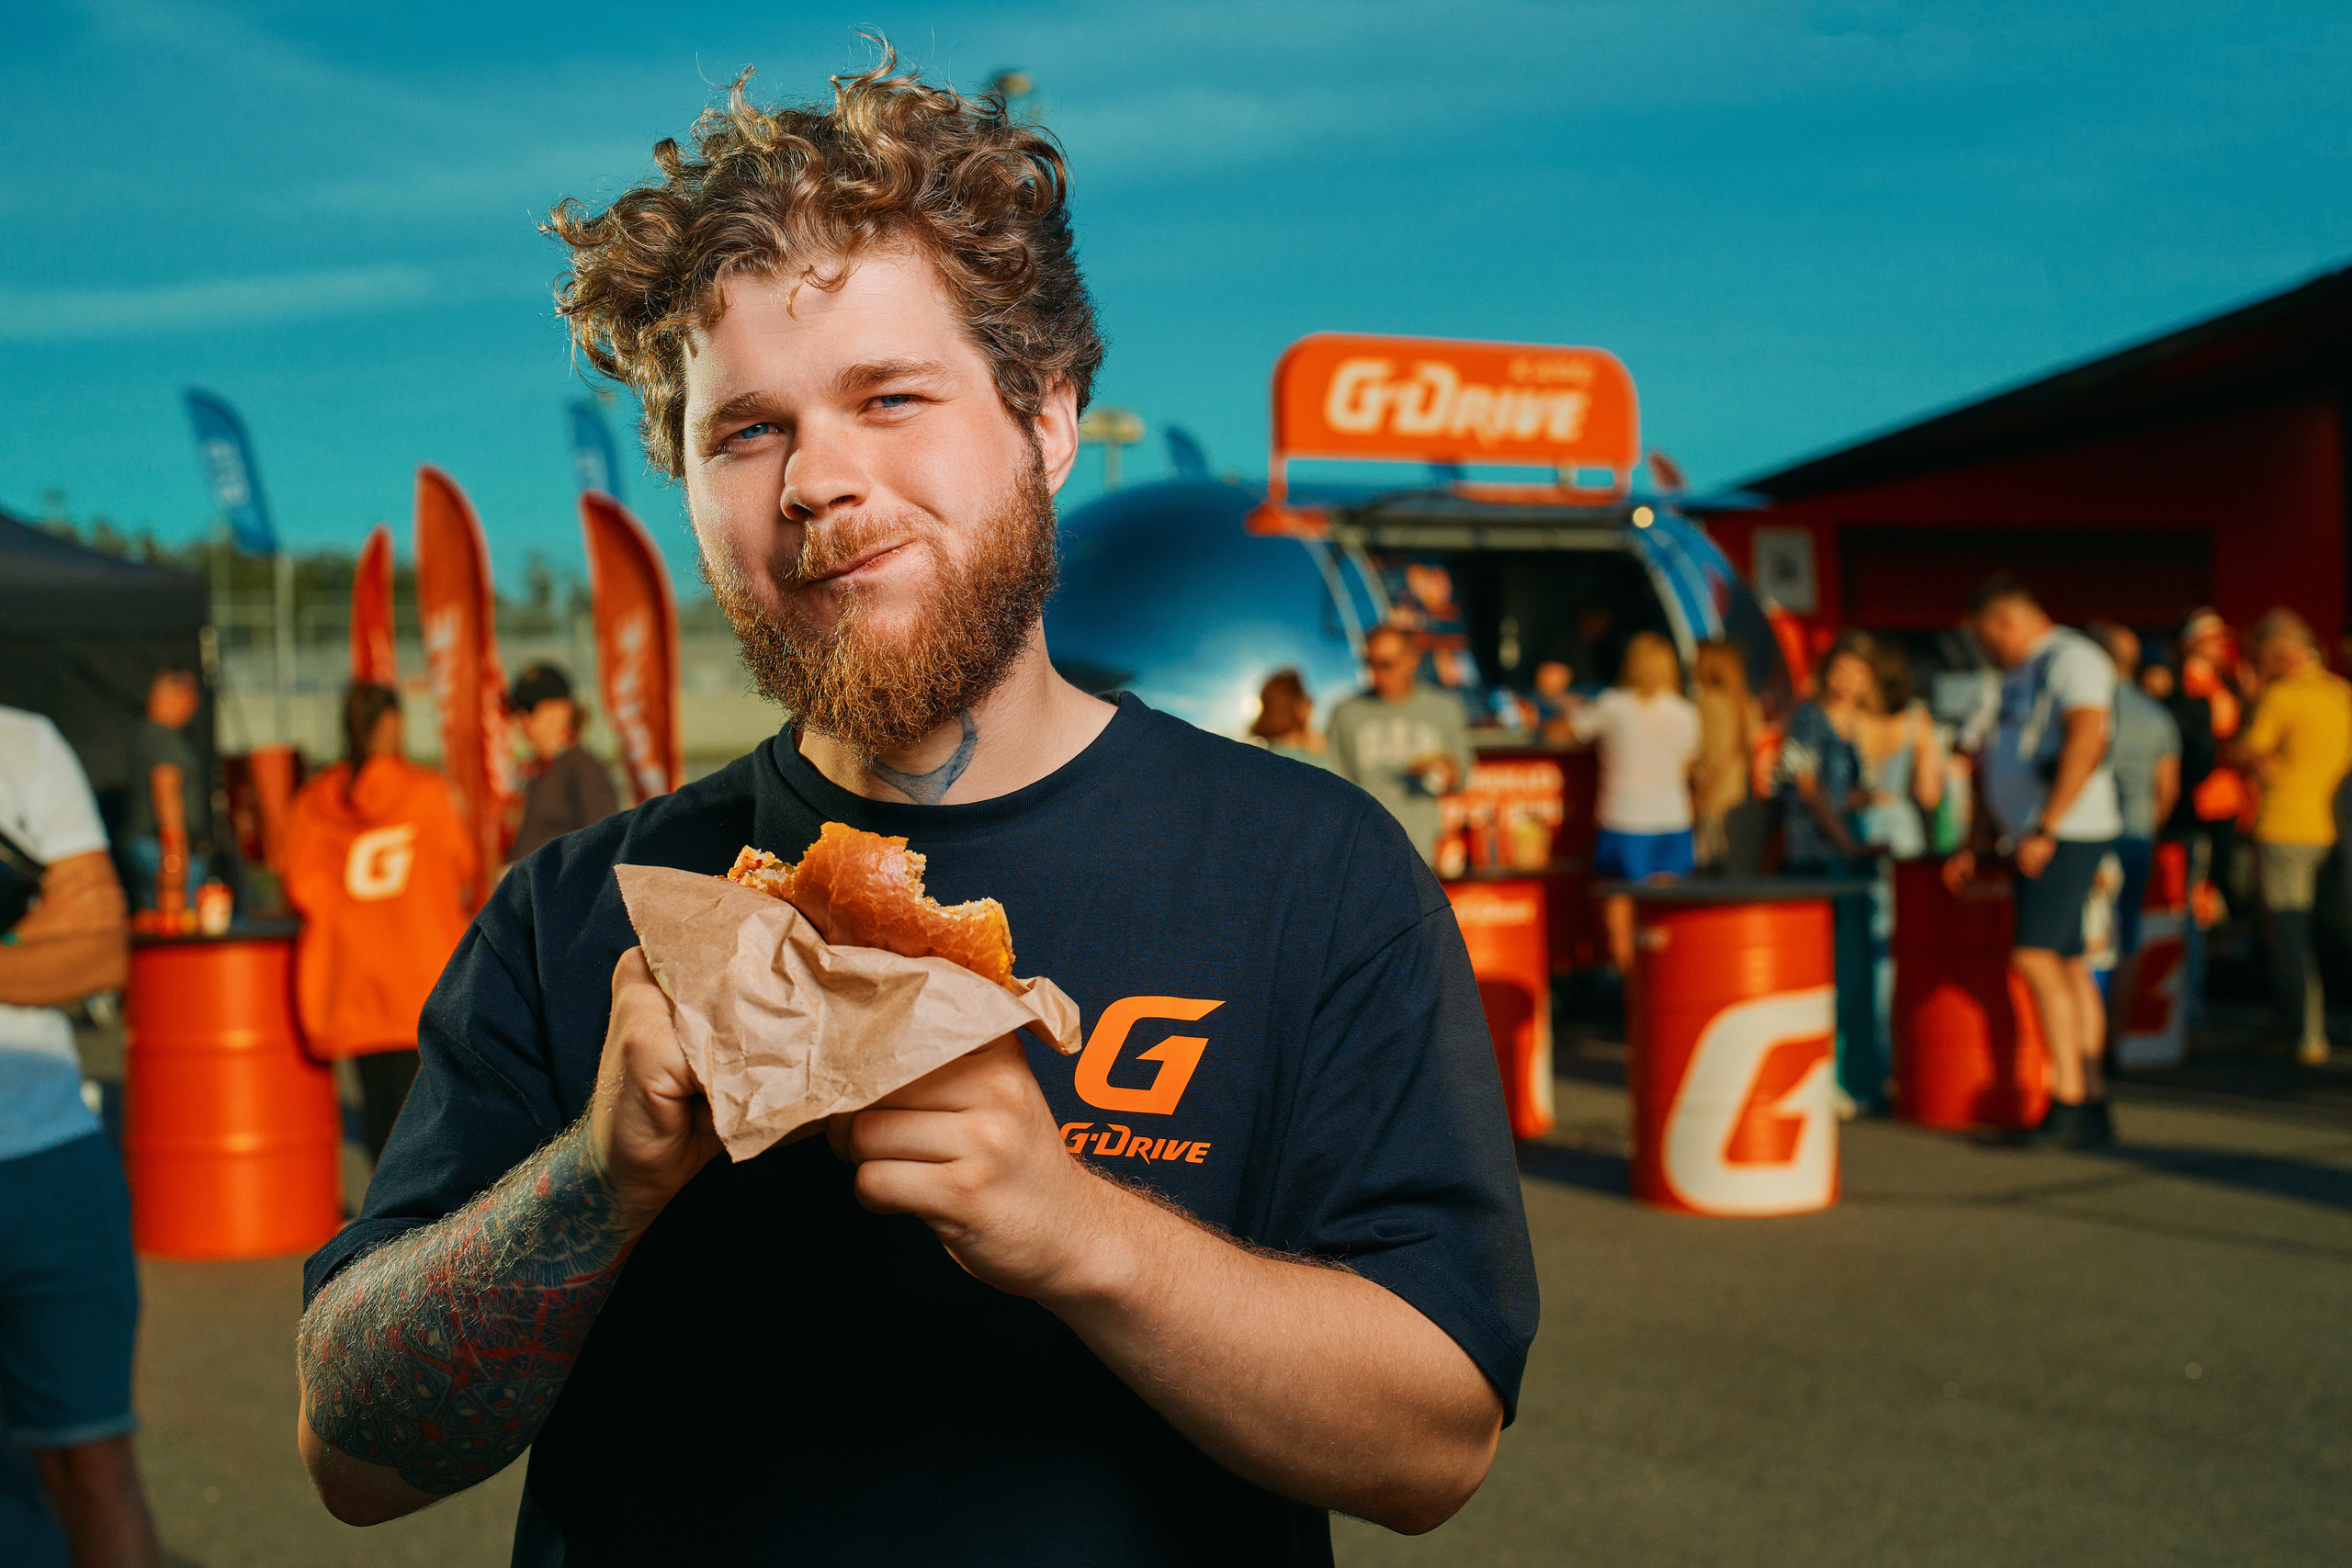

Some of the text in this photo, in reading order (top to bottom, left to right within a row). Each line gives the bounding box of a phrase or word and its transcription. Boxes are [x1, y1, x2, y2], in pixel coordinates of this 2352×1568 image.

[345, 822, 417, 901] G
[1074, 995, 1227, 1116] G
[1663, 986, 1837, 1213] G
